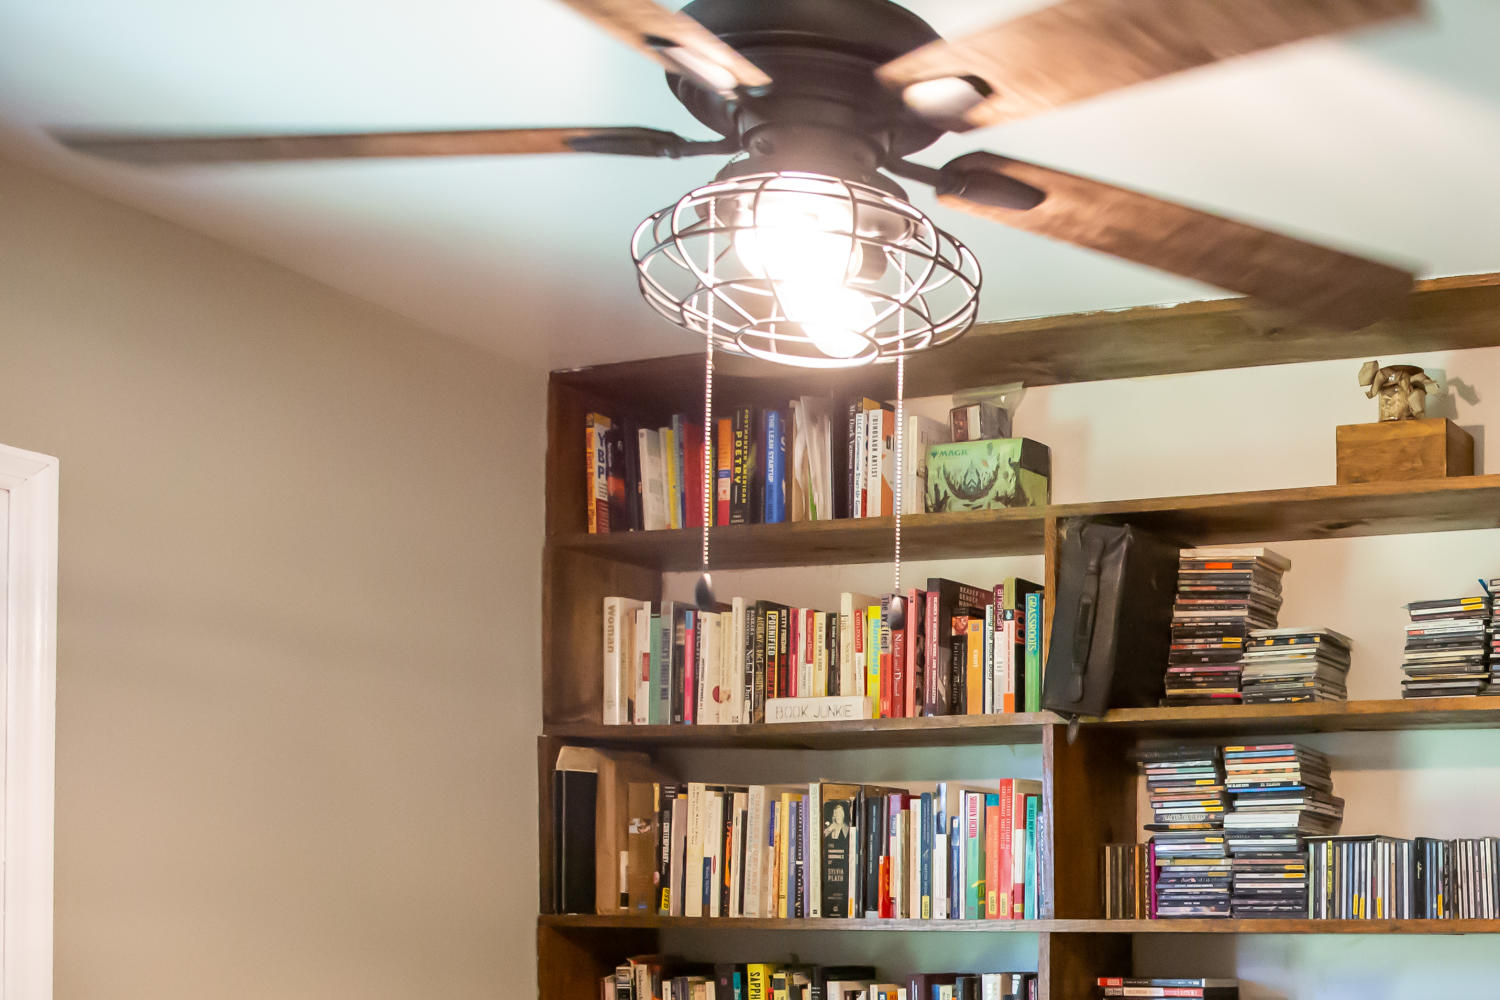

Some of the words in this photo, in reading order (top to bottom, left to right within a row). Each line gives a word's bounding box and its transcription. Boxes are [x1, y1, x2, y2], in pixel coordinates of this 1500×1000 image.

[767, 414, 775, 428] THE
[767, 430, 775, 449] LEAN
[734, 431, 743, 484] POETRY
[767, 451, 775, 482] STARTUP
[607, 604, 616, 653] Woman
[1027, 595, 1038, 651] GRASSROOTS
[872, 619, 880, 675] Manifesta
[775, 705, 808, 720] BOOK
[813, 704, 853, 719] JUNKIE
[662, 888, 670, 910] USED
